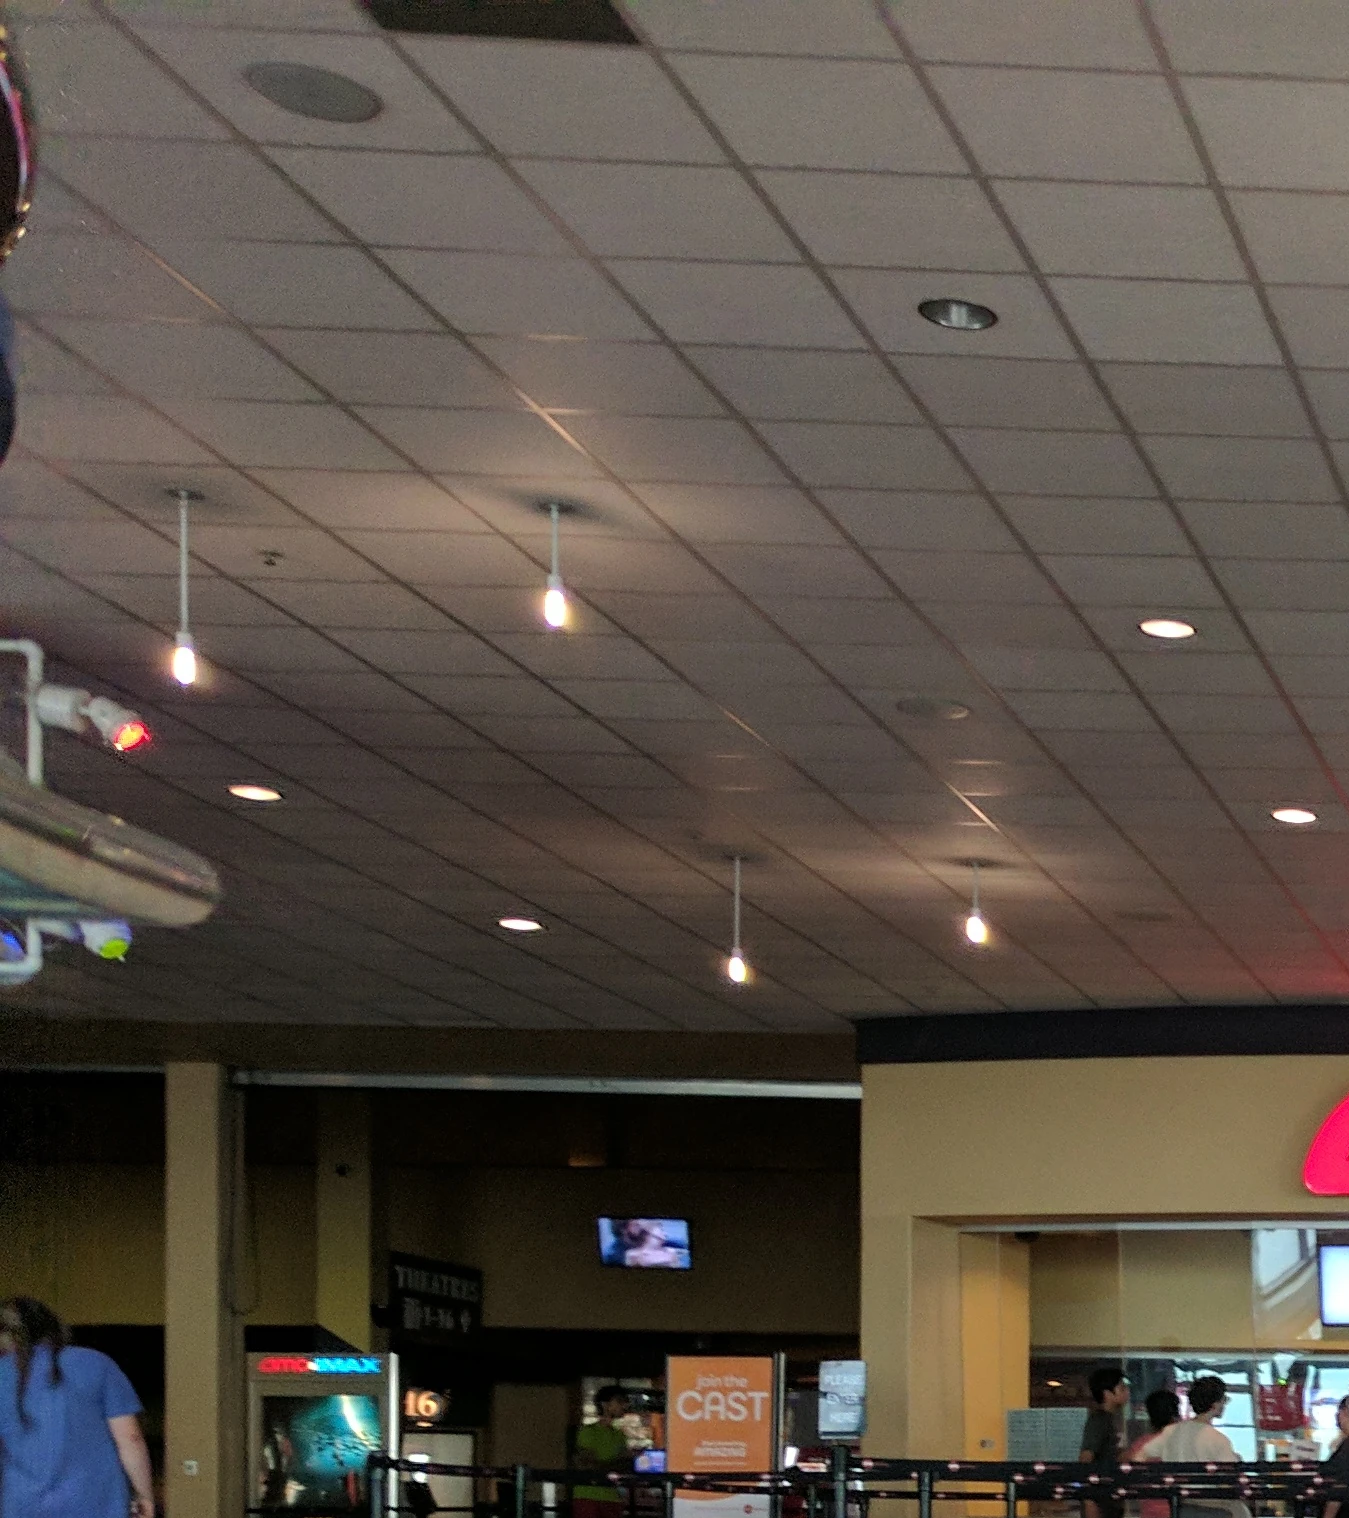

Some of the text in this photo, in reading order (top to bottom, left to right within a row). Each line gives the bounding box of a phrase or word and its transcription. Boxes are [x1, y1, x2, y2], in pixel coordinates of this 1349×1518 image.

[312, 1355, 383, 1374] IMAX
[723, 1375, 749, 1388] the
[404, 1389, 439, 1417] 16
[675, 1390, 770, 1422] CAST
